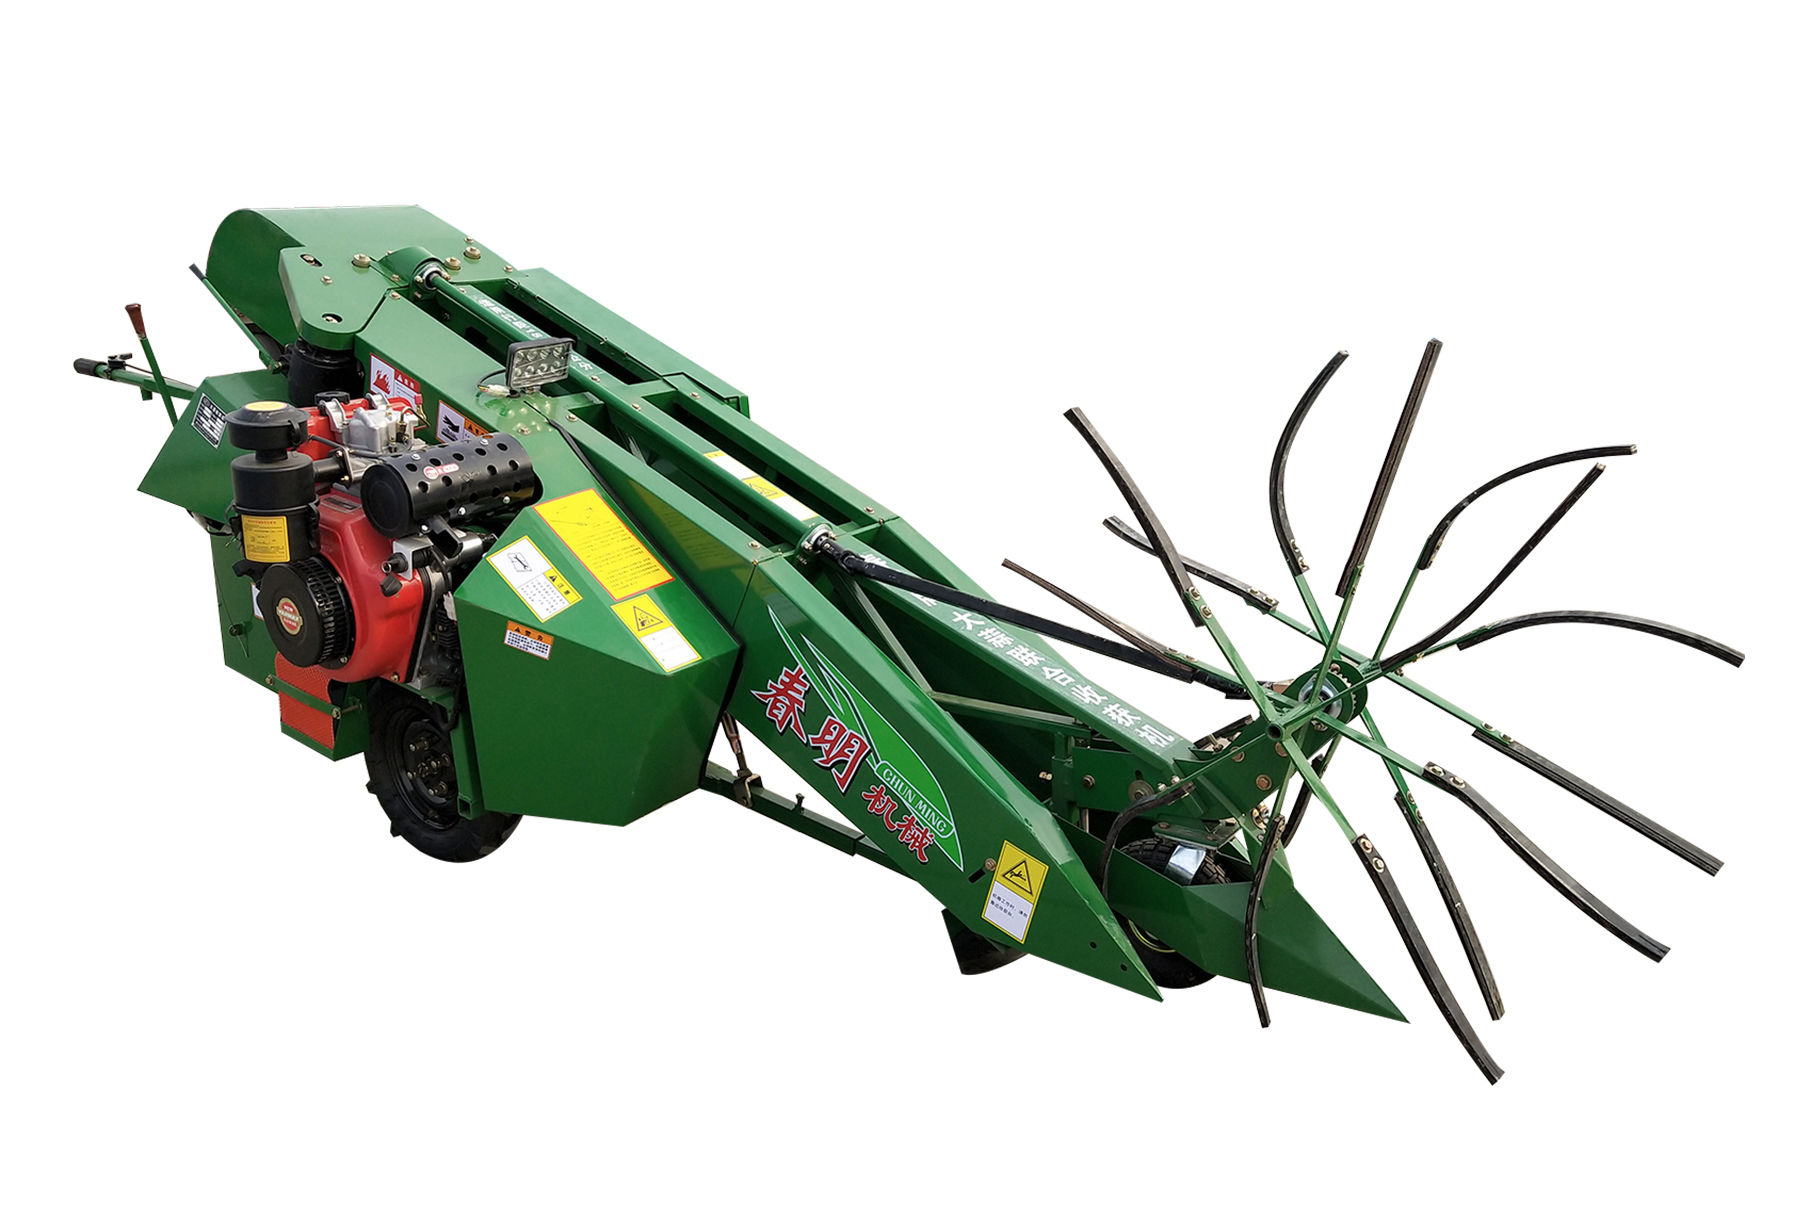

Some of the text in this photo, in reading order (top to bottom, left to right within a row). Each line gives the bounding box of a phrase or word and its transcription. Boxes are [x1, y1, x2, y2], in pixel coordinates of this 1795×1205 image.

[751, 664, 935, 862] 春明 机械
[882, 768, 949, 833] CHUN MING
